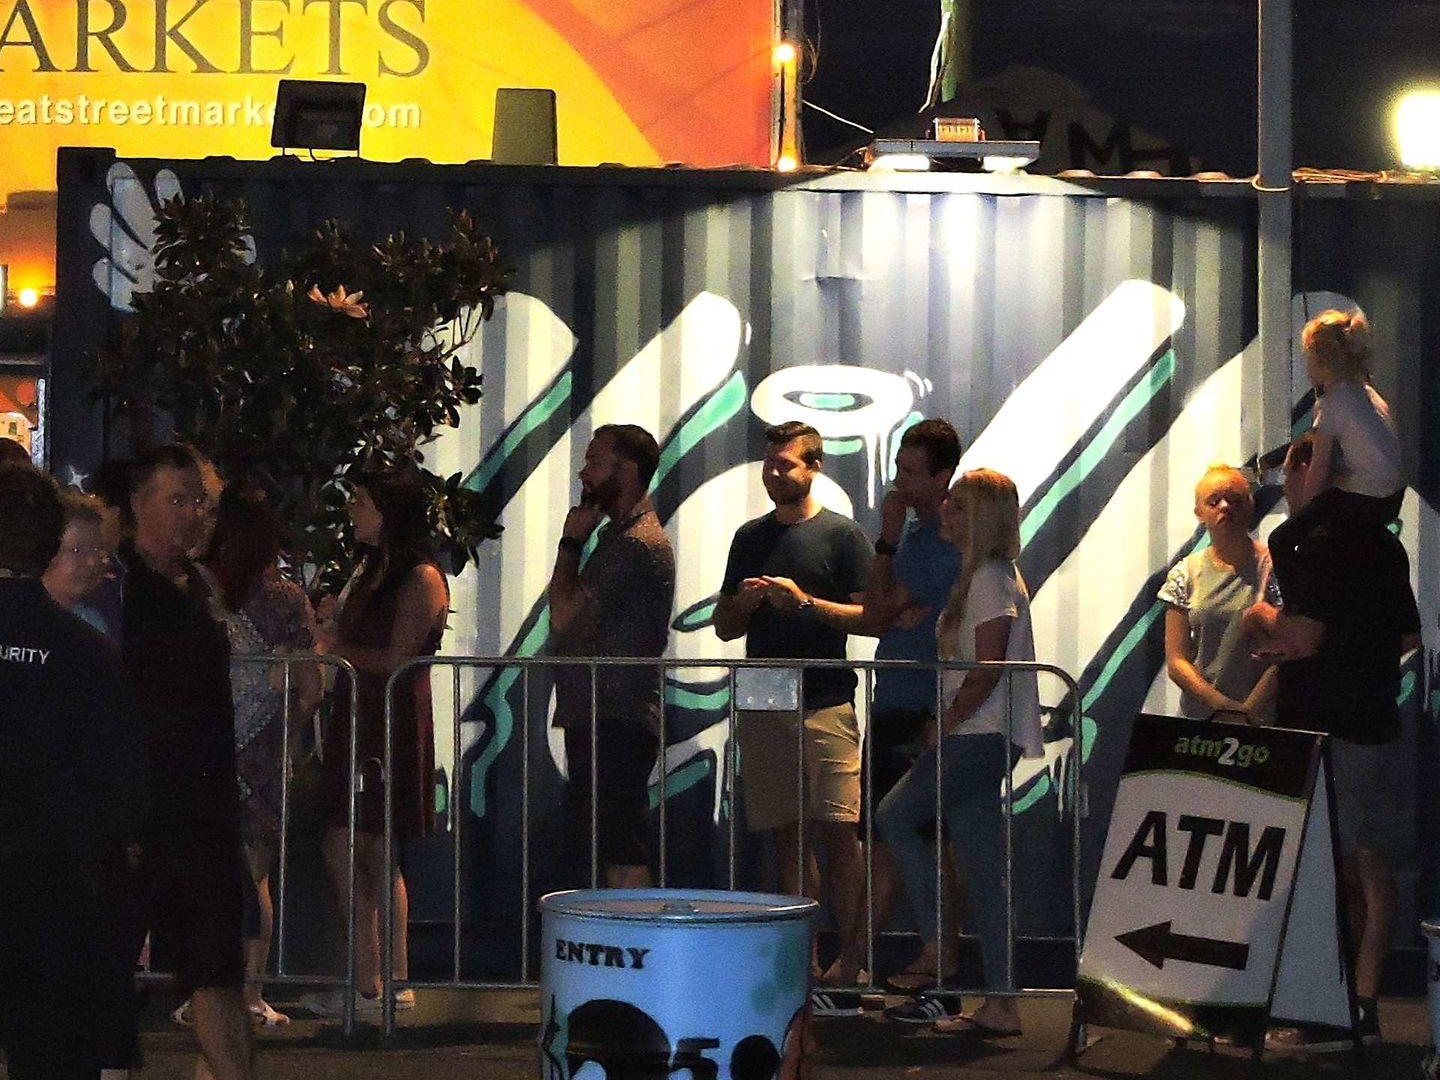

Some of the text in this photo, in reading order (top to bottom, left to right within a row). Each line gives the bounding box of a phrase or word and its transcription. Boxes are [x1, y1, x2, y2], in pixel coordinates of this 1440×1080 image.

[1173, 735, 1272, 769] atm2go
[1111, 810, 1287, 902] ATM
[555, 938, 651, 969] ENTRY
